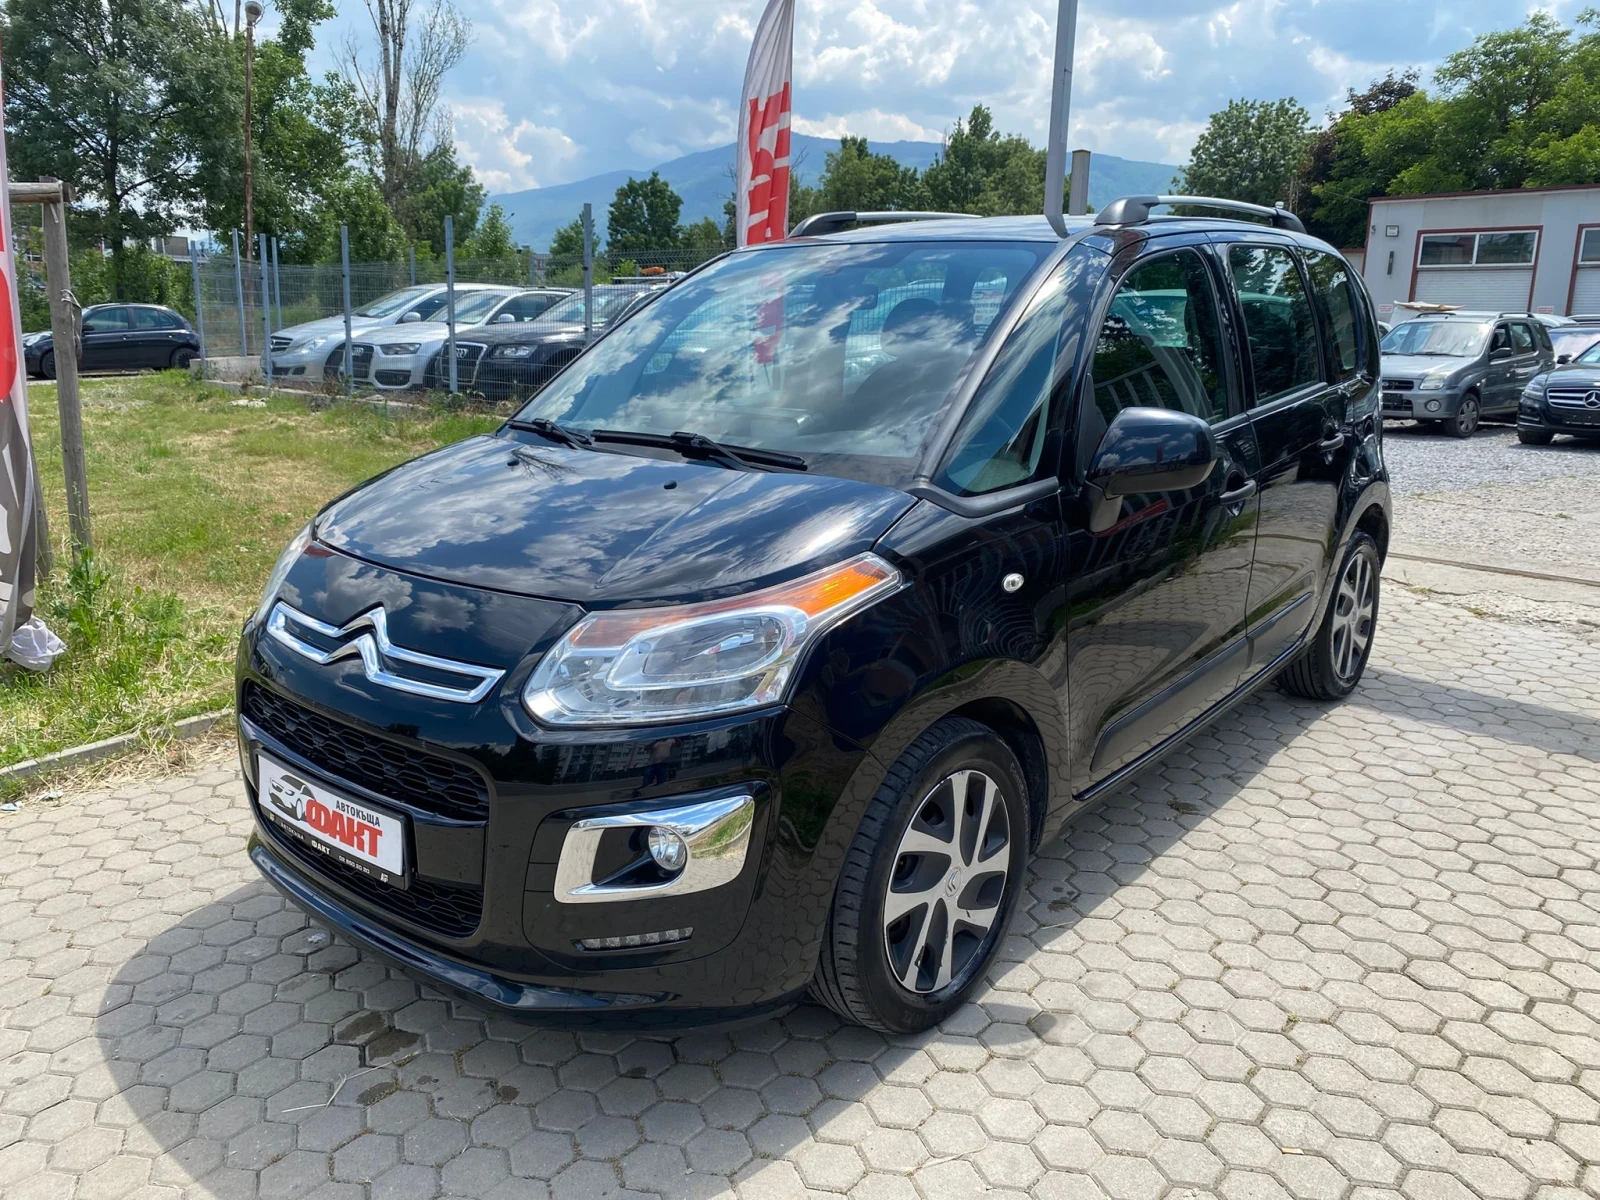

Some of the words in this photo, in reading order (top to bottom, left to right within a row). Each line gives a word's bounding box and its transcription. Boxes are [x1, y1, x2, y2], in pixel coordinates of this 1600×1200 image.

[336, 800, 380, 827] АВТОКЪЩА
[306, 799, 382, 858] ФАКТ
[311, 840, 330, 855] ФАКТ
